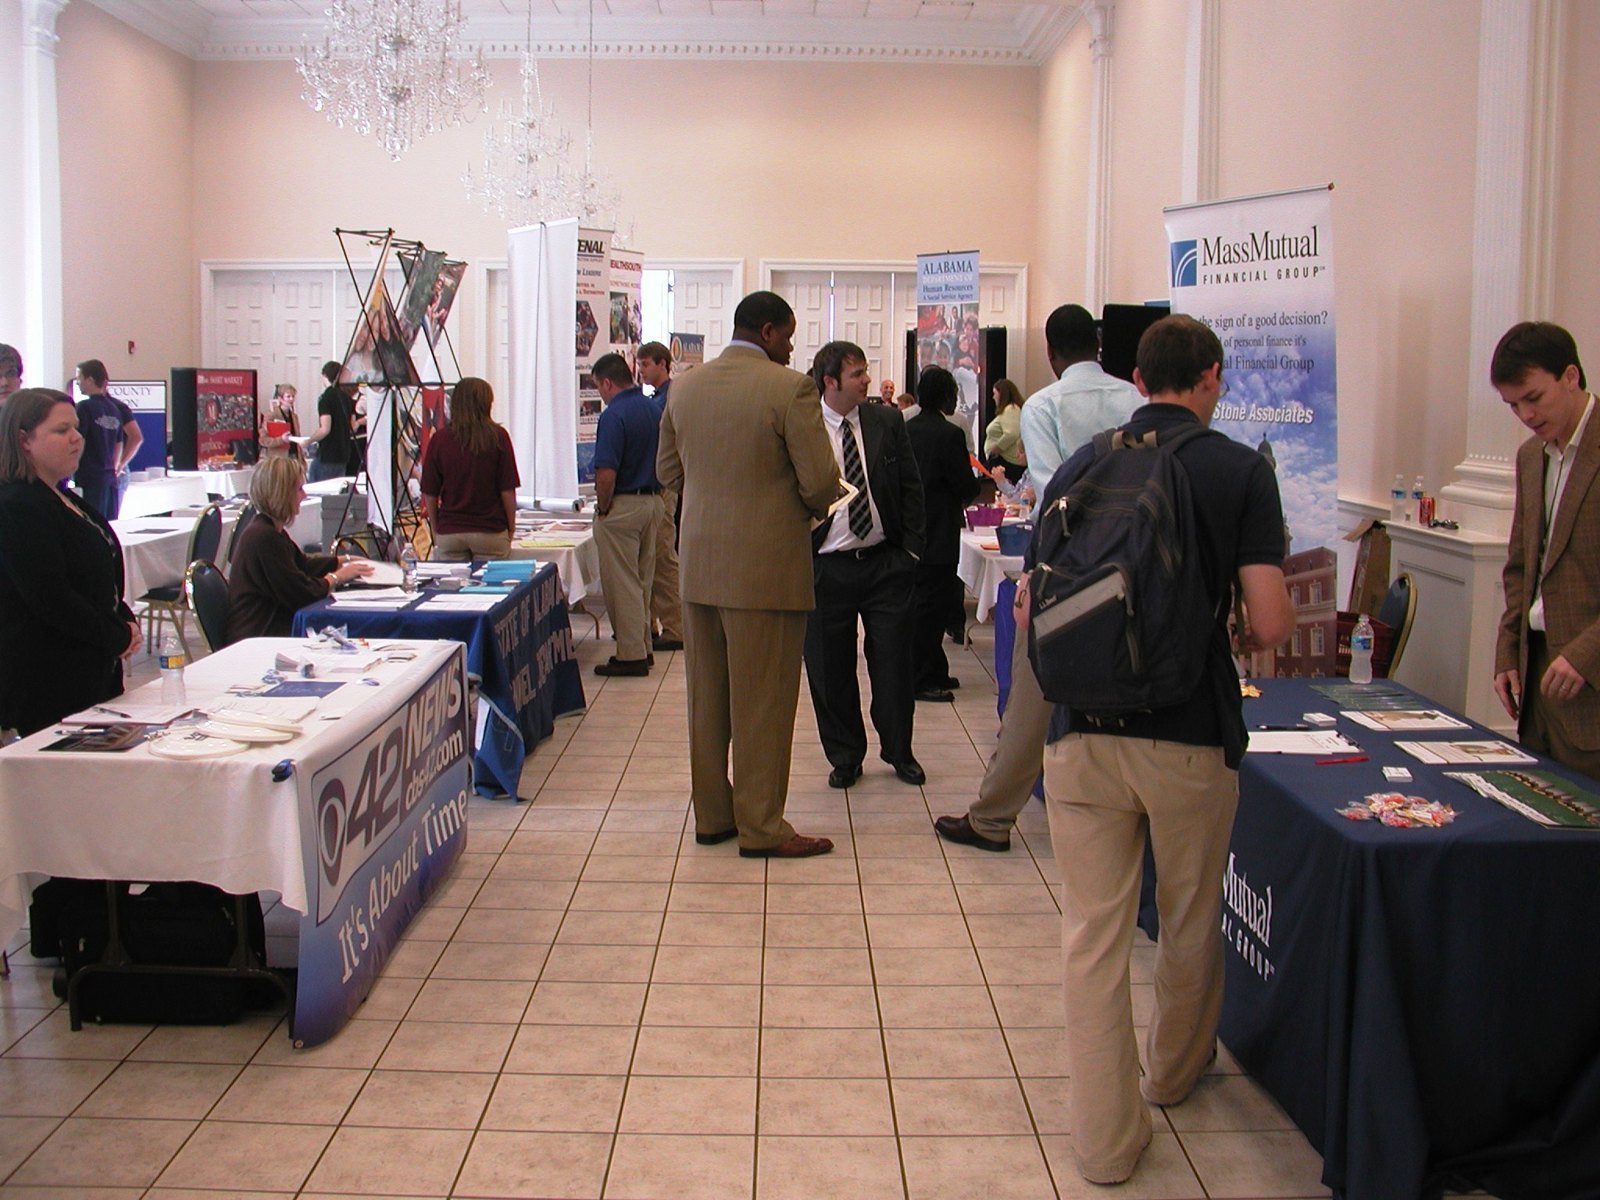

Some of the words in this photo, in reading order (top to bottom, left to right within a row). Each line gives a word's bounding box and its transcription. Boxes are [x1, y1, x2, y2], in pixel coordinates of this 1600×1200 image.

[577, 239, 605, 254] ENAL
[1202, 225, 1319, 267] MassMutual
[922, 259, 973, 275] ALABAMA
[1203, 270, 1267, 284] FINANCIAL
[1215, 314, 1234, 331] sign
[1236, 314, 1247, 327] of
[1247, 317, 1253, 327] a
[1255, 313, 1277, 330] good
[1279, 311, 1328, 326] decision?
[1224, 336, 1234, 347] of
[1234, 335, 1265, 350] personal
[1266, 335, 1292, 347] finance
[1235, 355, 1278, 369] Financial
[1280, 355, 1315, 374] Group
[1213, 402, 1246, 420] Stone
[1249, 403, 1315, 423] Associates
[346, 727, 402, 849] 42
[406, 656, 462, 769] NEWS
[338, 904, 369, 984] It's
[369, 829, 419, 931] About
[422, 789, 468, 855] Time
